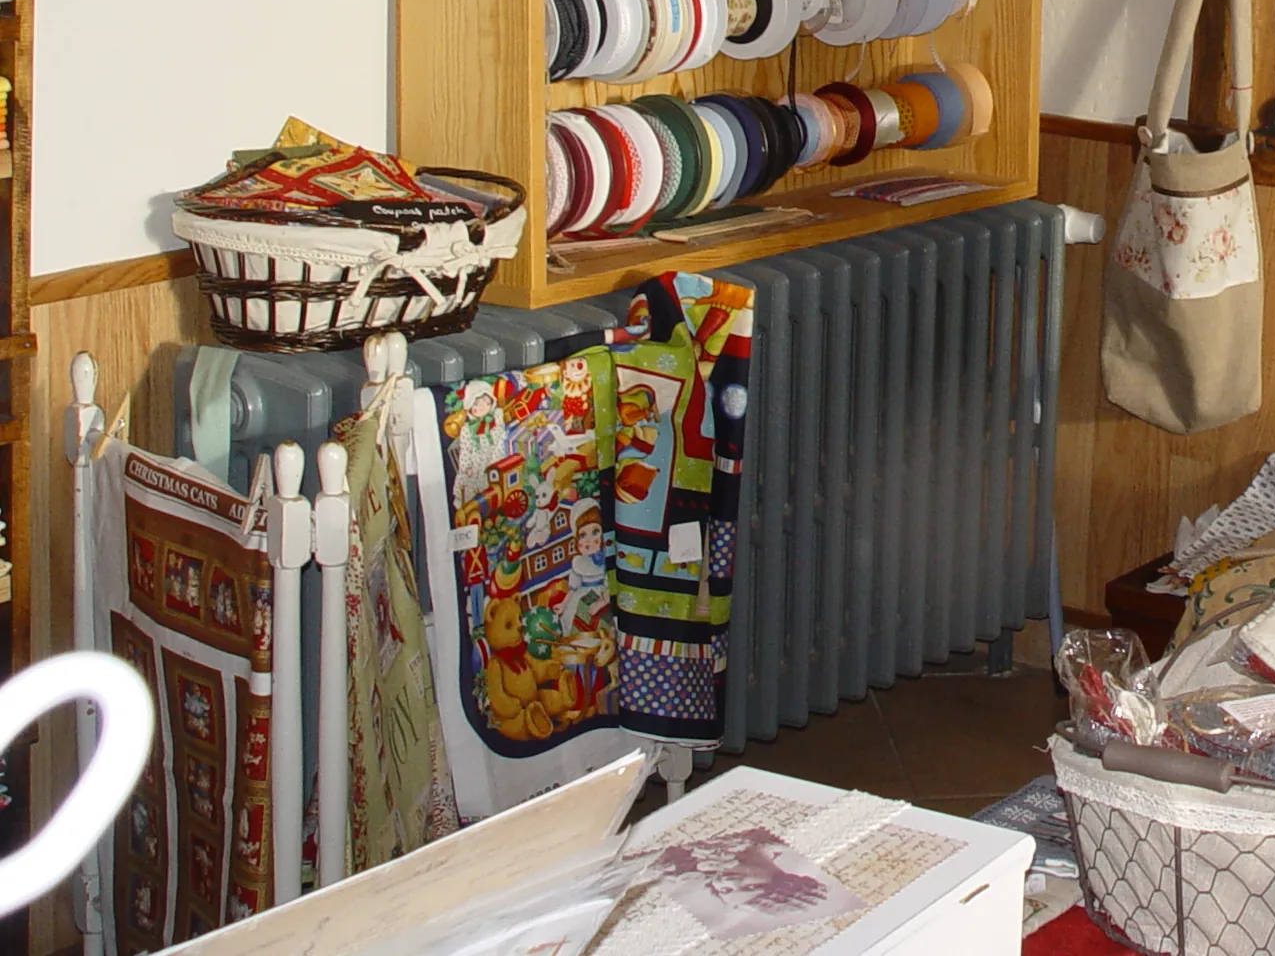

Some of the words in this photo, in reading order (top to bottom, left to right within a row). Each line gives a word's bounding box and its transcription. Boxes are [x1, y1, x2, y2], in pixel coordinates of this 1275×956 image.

[372, 205, 422, 218] Coupons
[129, 459, 189, 499] CHRISTMAS
[190, 488, 218, 510] CATS
